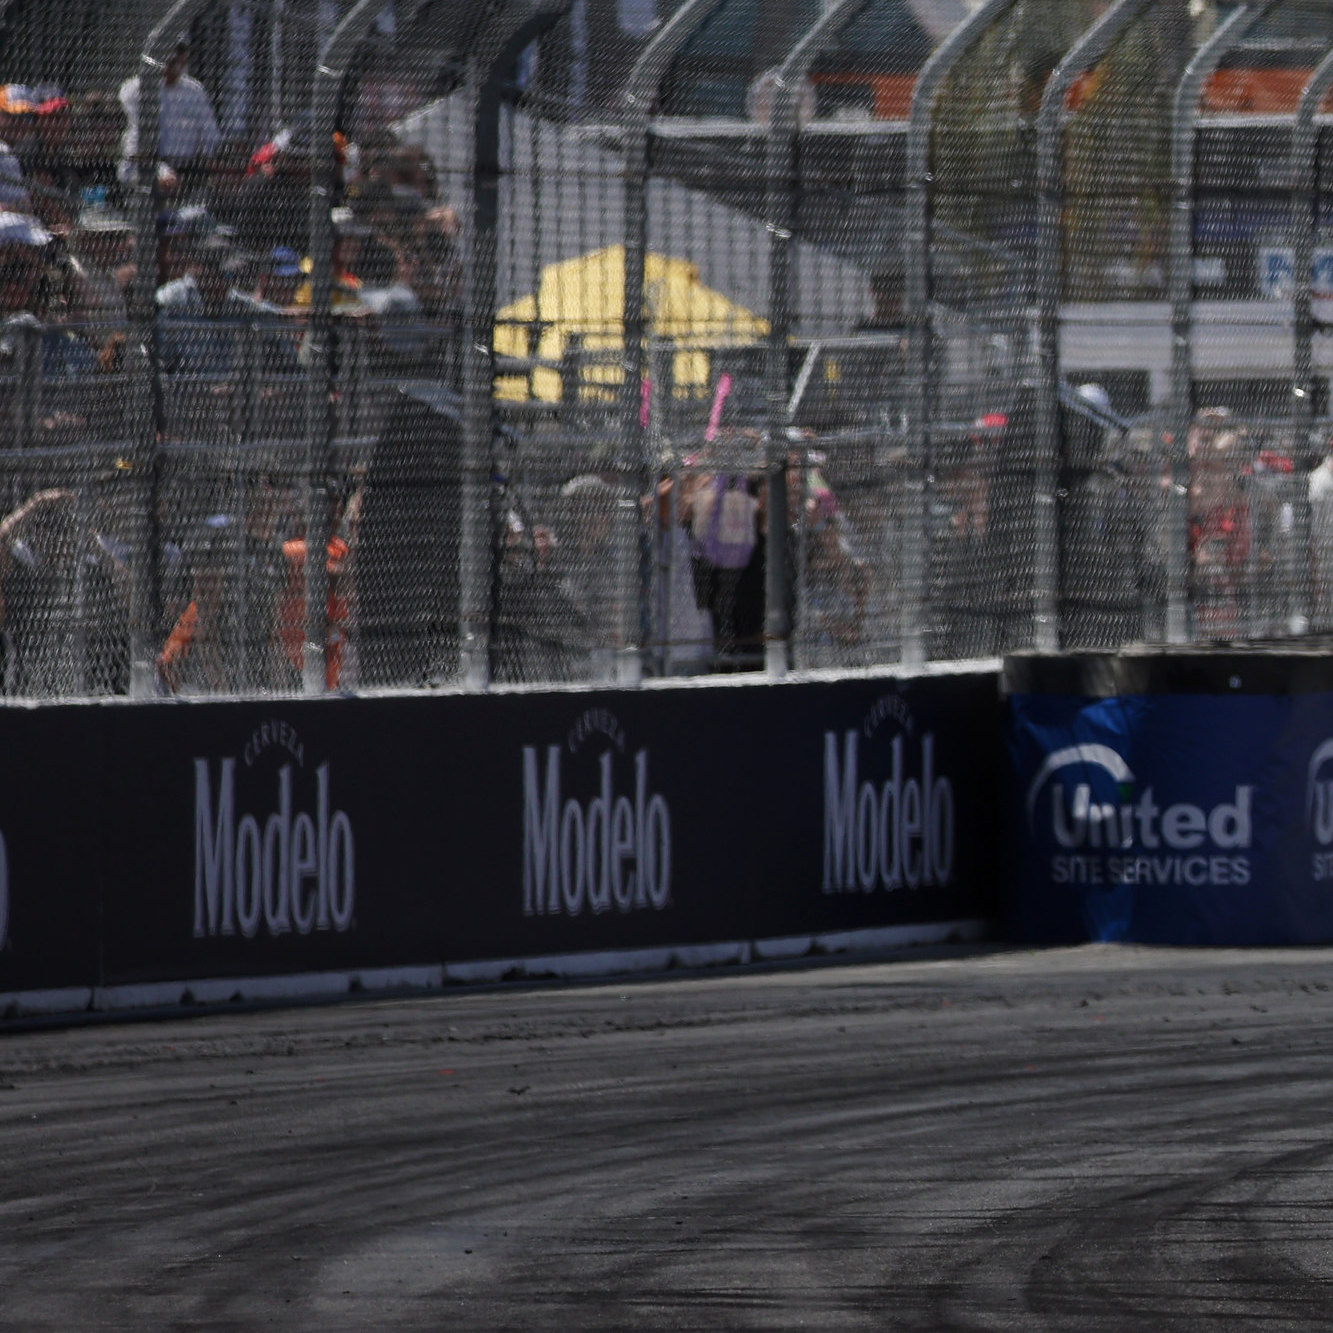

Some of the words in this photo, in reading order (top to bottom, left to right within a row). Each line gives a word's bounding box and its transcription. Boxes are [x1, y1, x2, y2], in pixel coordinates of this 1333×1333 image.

[193, 756, 355, 938] Modelo
[522, 745, 671, 916] Modelo
[822, 729, 955, 894] Modelo
[1051, 783, 1253, 848] United
[1051, 854, 1102, 884] SITE
[1109, 854, 1252, 886] SERVICES
